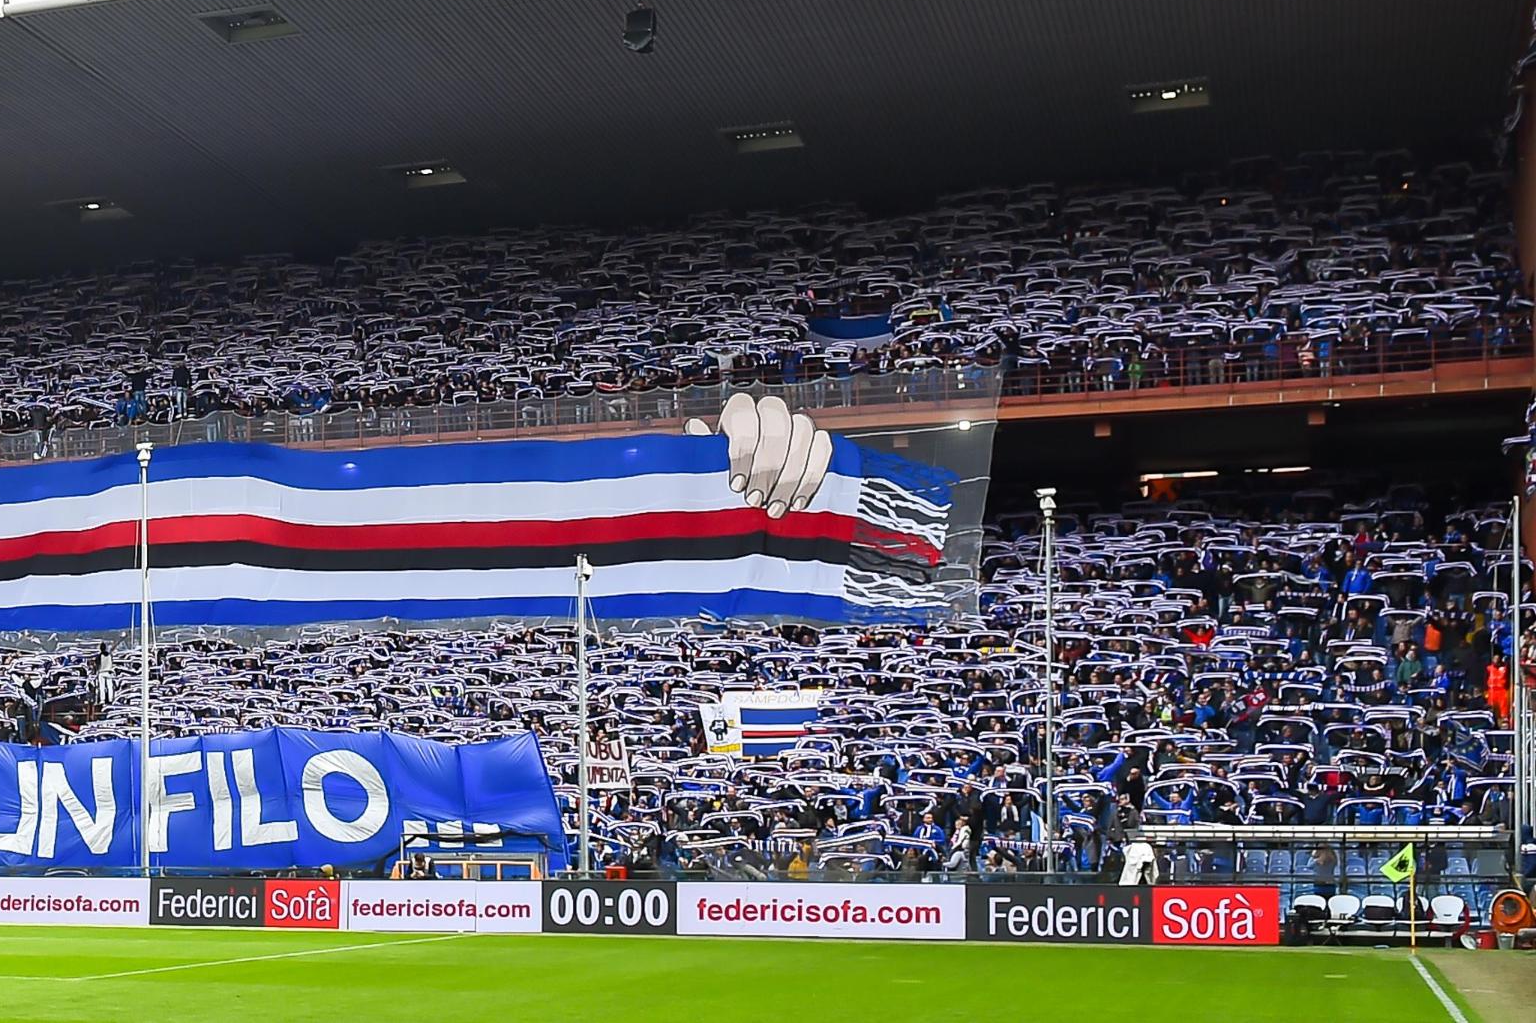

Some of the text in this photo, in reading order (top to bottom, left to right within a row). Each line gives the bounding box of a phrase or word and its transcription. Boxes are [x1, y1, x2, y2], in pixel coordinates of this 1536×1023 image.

[734, 693, 816, 704] SAMPDORI
[158, 886, 333, 921] Federici Sofà
[352, 898, 531, 918] federicisofa.com
[550, 887, 669, 927] 00:00
[696, 898, 941, 925] federicisofa.com
[988, 893, 1256, 940] Federici Sofà
